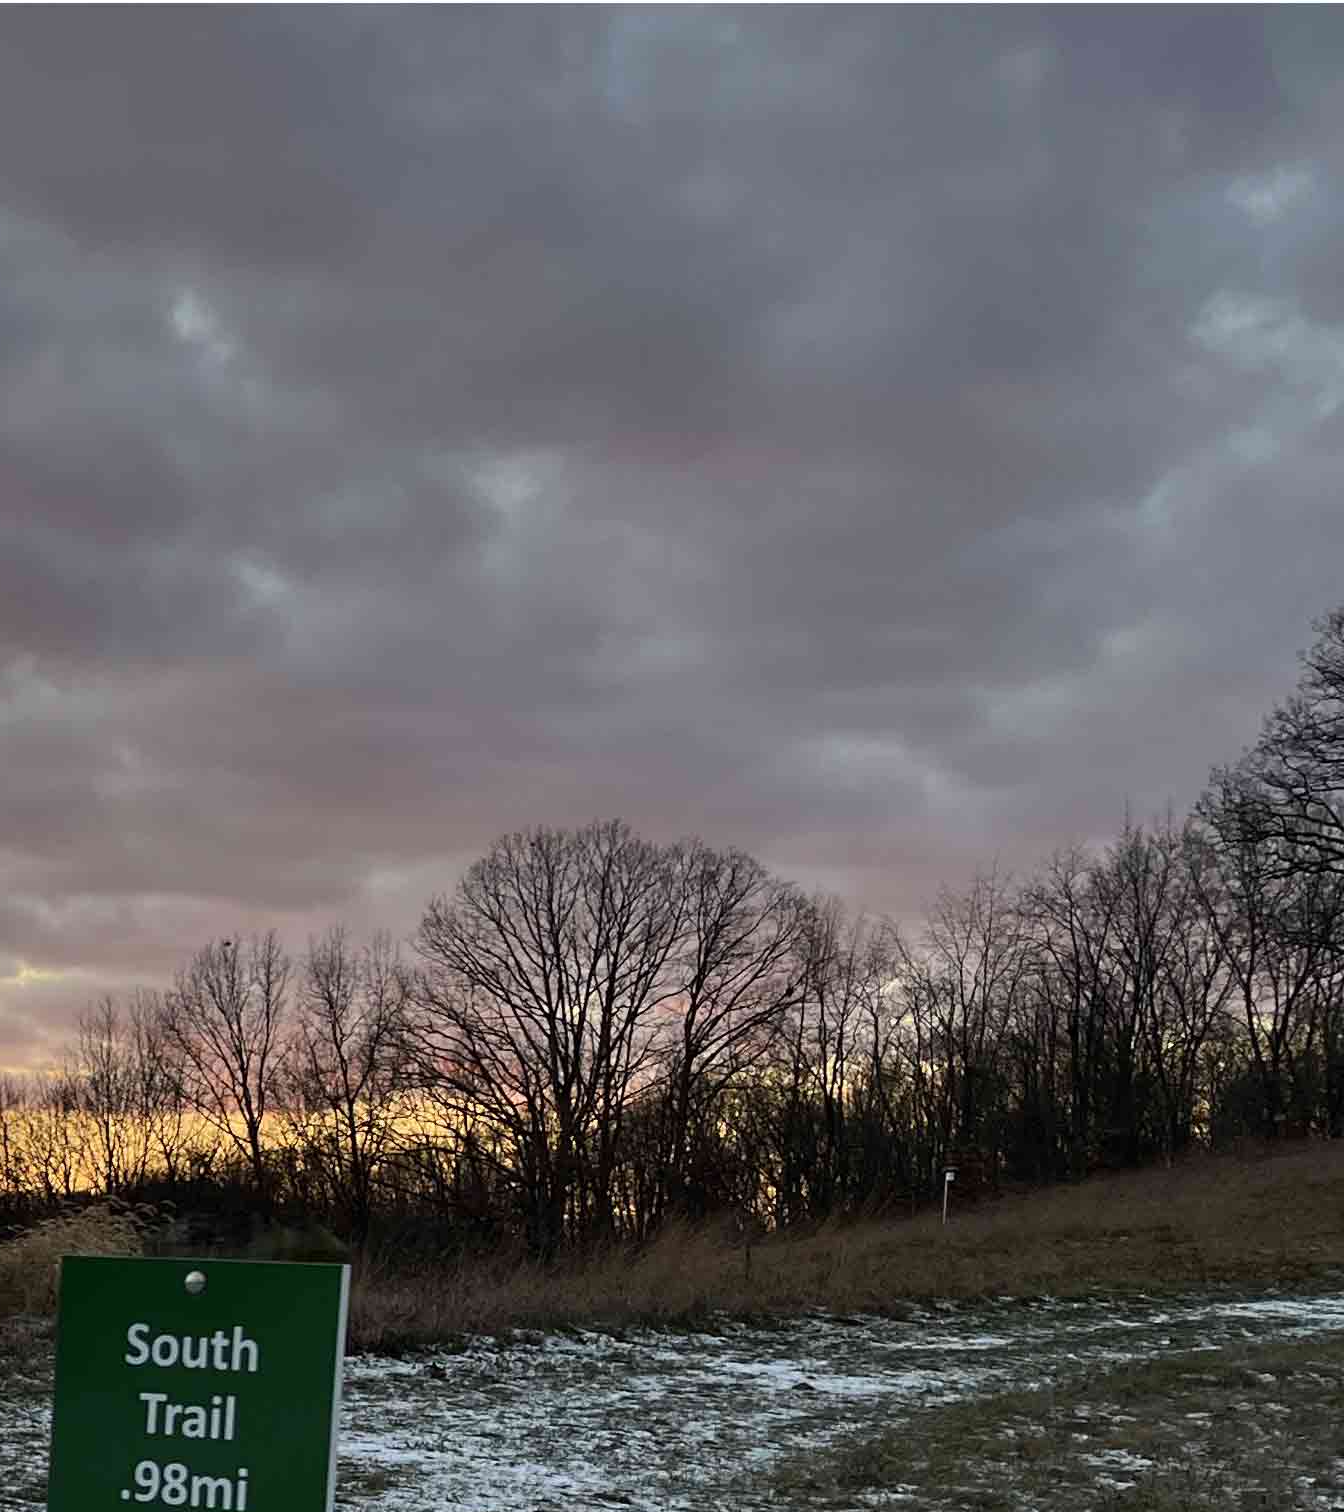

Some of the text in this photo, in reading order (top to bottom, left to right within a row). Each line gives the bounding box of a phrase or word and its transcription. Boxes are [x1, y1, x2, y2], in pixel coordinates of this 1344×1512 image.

[124, 1322, 259, 1372] South
[139, 1392, 236, 1441] Trail
[120, 1460, 249, 1512] .98mi
